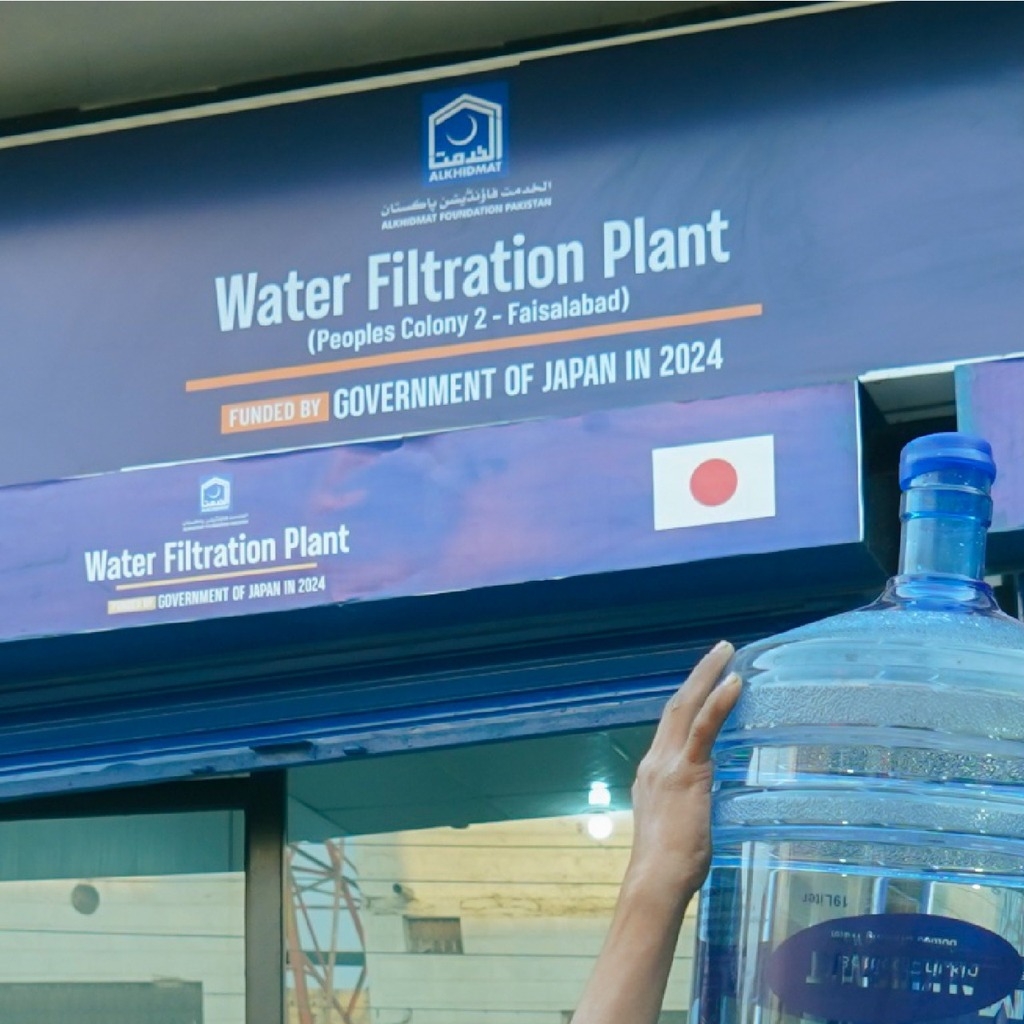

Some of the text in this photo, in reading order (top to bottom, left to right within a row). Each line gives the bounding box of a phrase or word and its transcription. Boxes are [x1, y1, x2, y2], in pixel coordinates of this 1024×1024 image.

[429, 162, 503, 182] ALKHIDMAT
[381, 197, 552, 230] ALKHIDMAT FOUNDATION PAKISTAN
[215, 209, 731, 332] Water Filtration Plant
[307, 316, 395, 355] (Peoples
[401, 308, 469, 344] Colony
[474, 307, 487, 330] 2
[507, 286, 631, 326] Faisalabad)
[228, 338, 724, 428] FUNDED BY GOVERNMENT OF JAPAN IN 2024
[84, 524, 350, 582] Water Filtration Plant
[157, 586, 229, 610] GOVERNMENT
[232, 583, 246, 600] OF
[248, 580, 281, 599] JAPAN
[283, 578, 296, 595] IN
[297, 575, 326, 593] 2024
